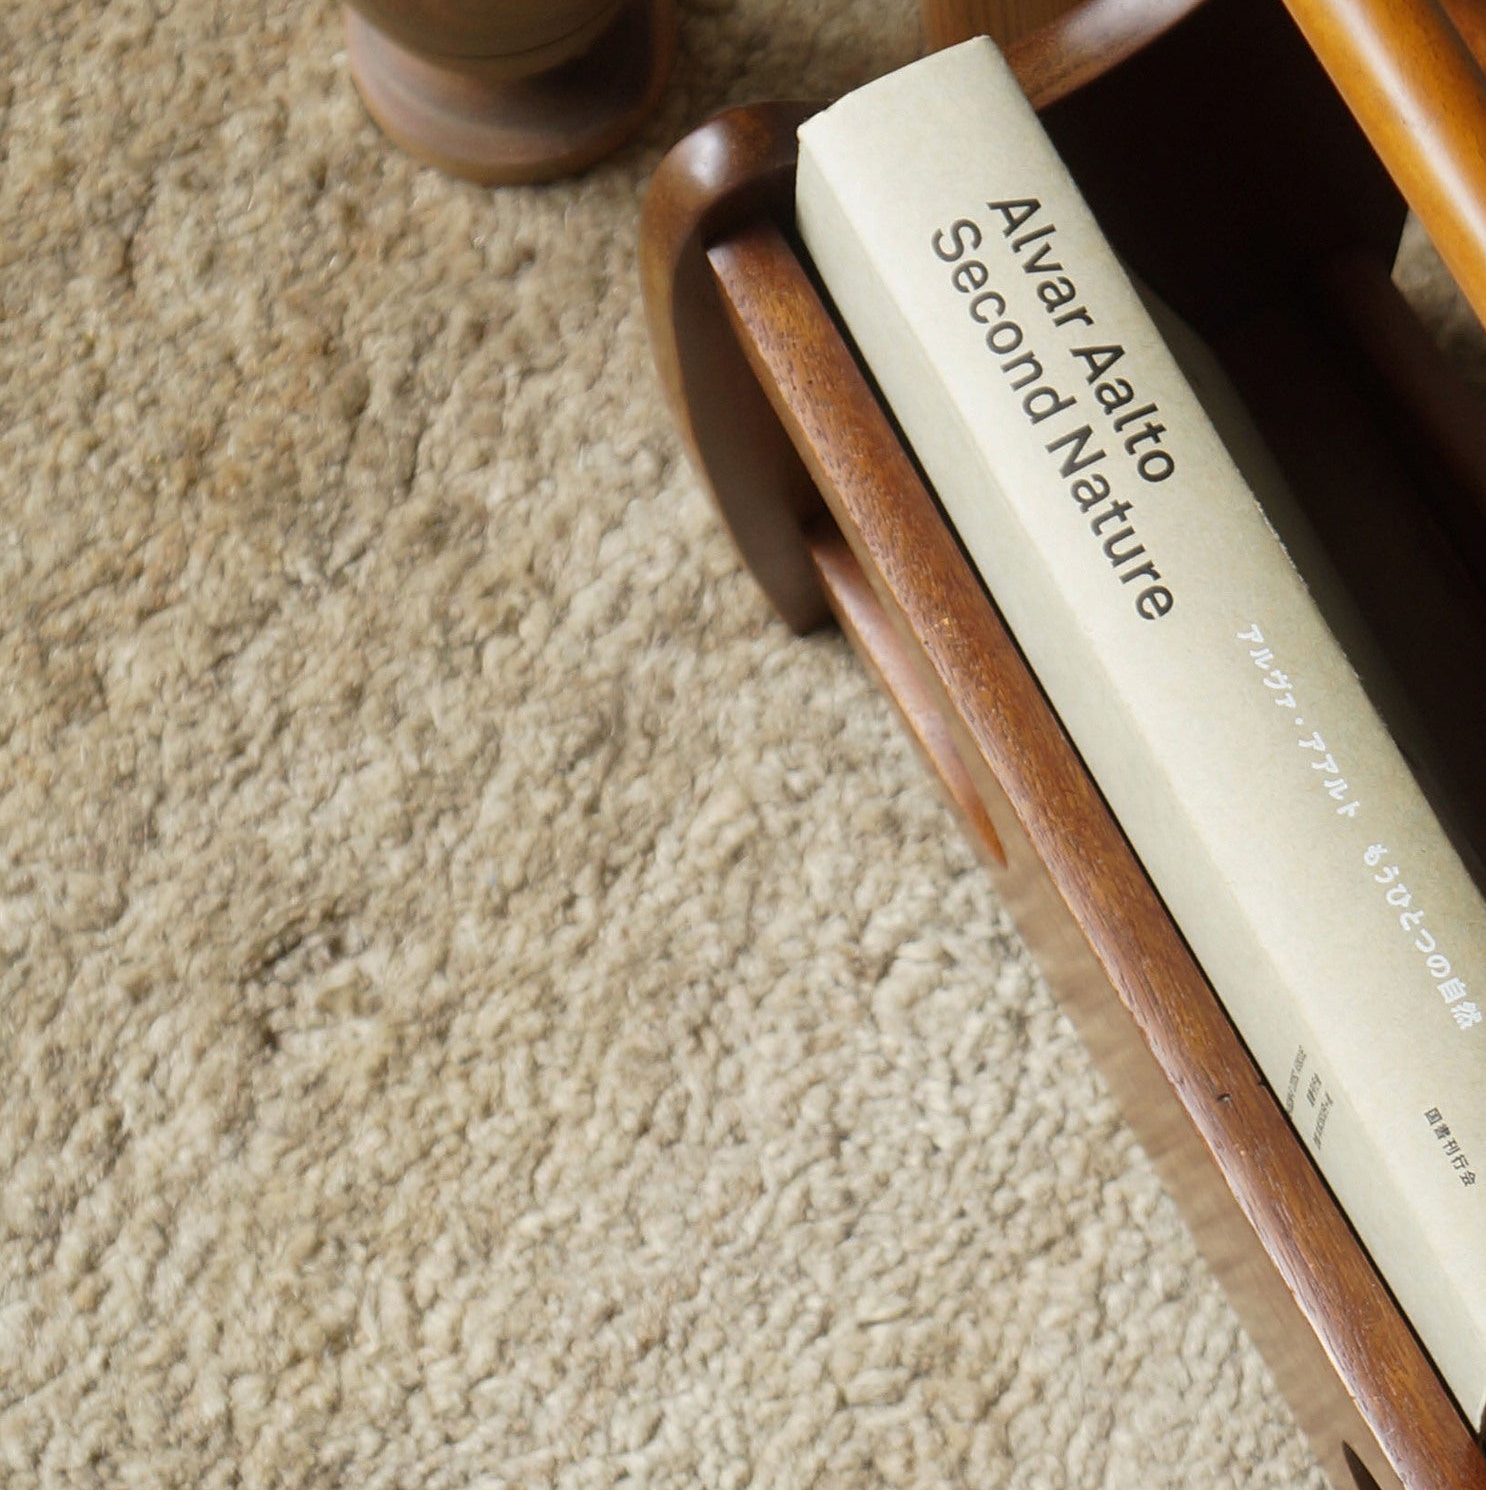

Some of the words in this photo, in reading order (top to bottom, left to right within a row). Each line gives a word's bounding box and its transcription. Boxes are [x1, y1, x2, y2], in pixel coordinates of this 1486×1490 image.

[931, 218, 1077, 425] Second
[1045, 424, 1174, 621] Nature
[987, 197, 1094, 327] Alvar
[1070, 345, 1175, 483] Aalto
[1237, 623, 1360, 817] アルヴァ・アアルト
[1363, 843, 1482, 1030] もうひとつの自然
[1424, 1107, 1476, 1186] 国書刊行会
